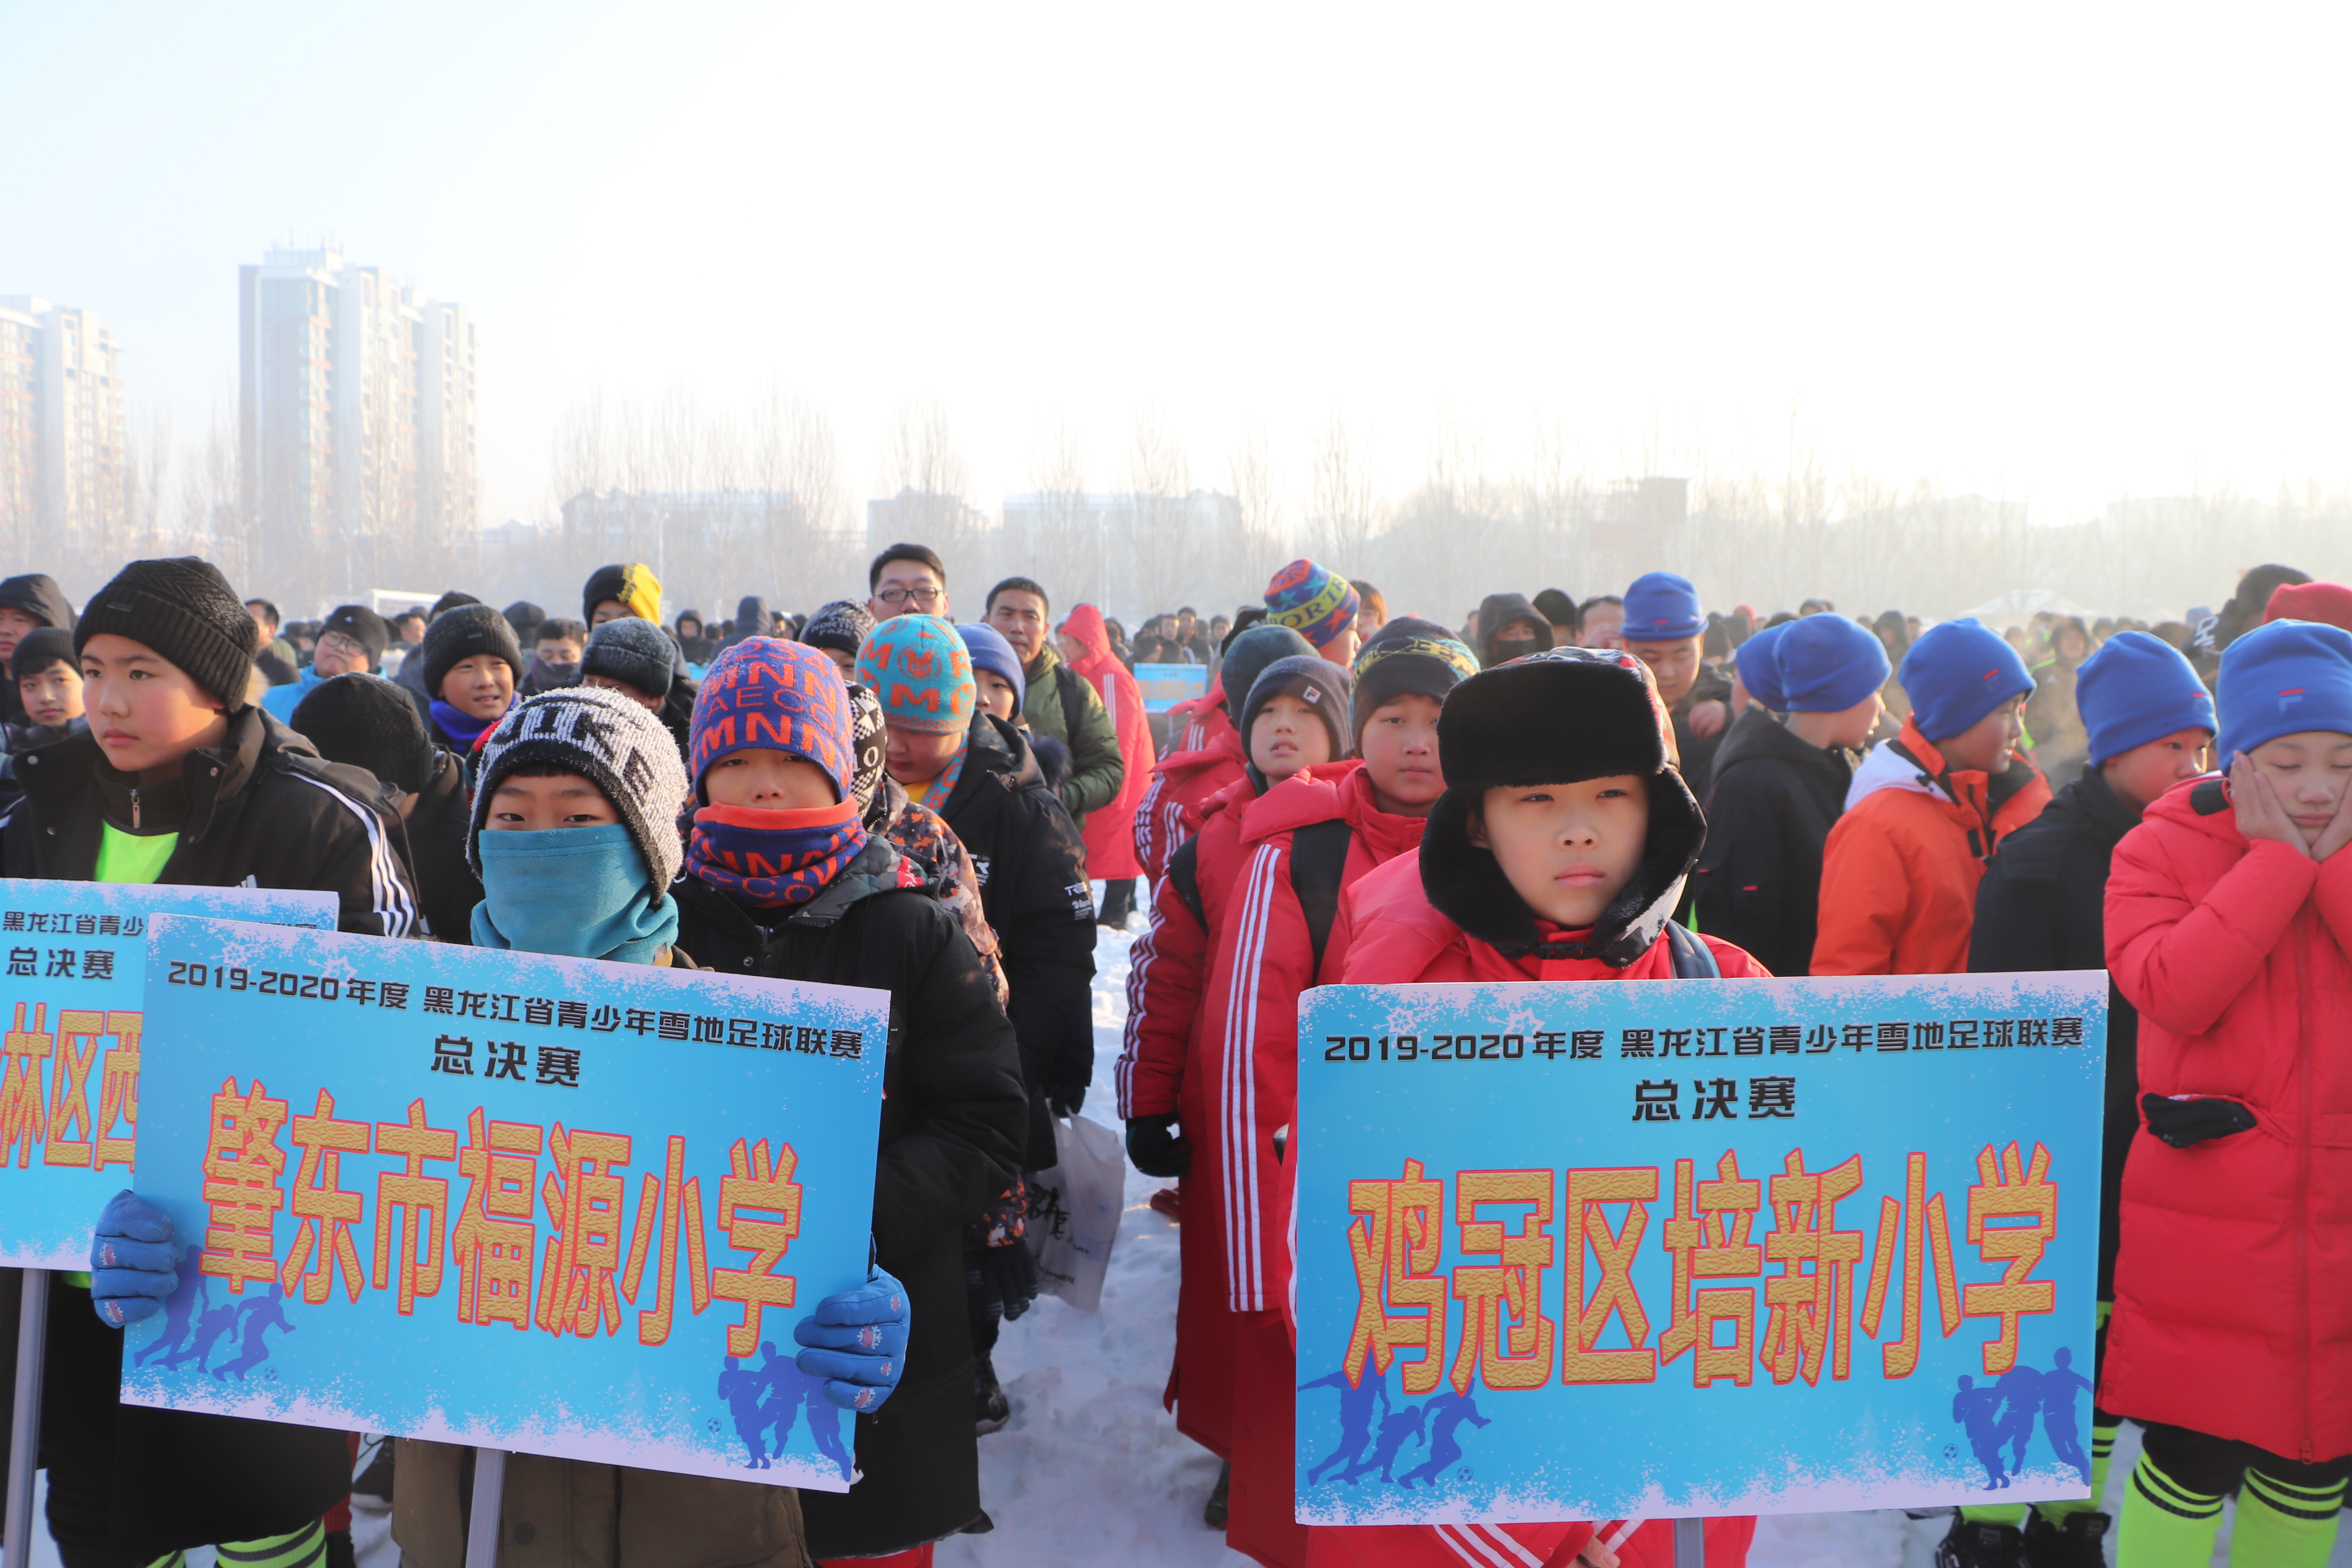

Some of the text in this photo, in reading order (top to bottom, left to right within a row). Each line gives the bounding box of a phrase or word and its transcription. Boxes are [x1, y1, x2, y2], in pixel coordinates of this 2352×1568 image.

[6, 946, 115, 980] 总决赛
[168, 961, 863, 1060] 2019-2020年度 黑龙江省青少年雪地足球联赛
[430, 1033, 580, 1087] 总决赛
[1324, 1016, 2083, 1061] 2019-2020年度 黑龙江省青少年雪地足球联赛
[1632, 1076, 1796, 1121] 总决赛
[198, 1075, 803, 1359] 肇东市福源小学
[1342, 1139, 2058, 1398] 鸡冠区培新小学
